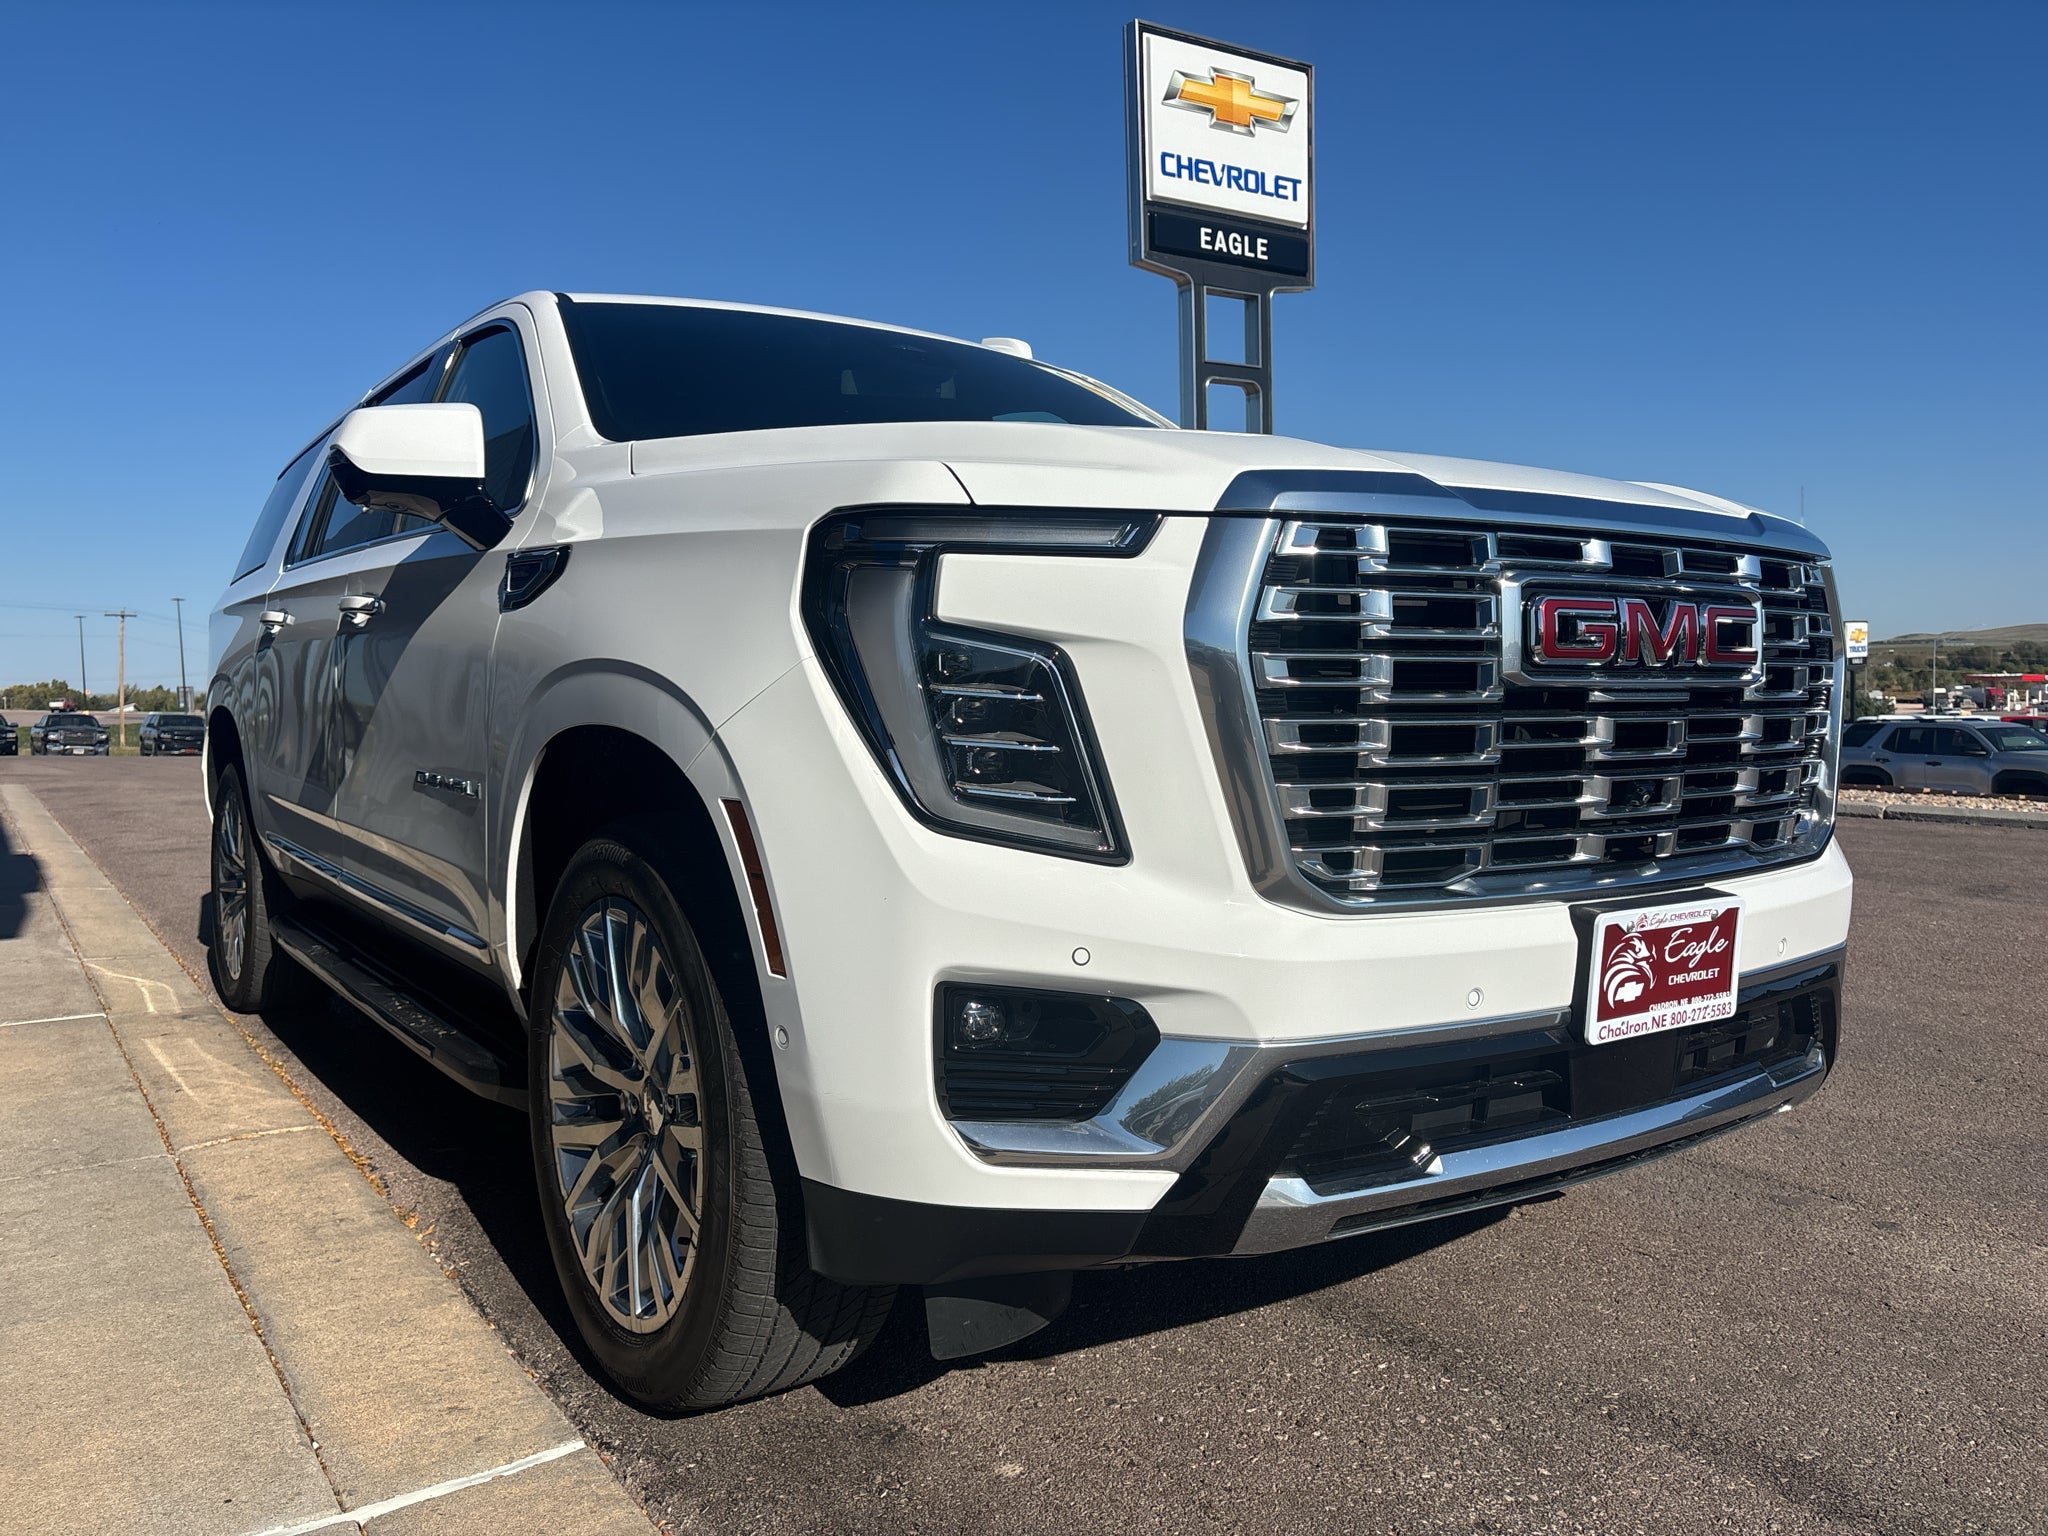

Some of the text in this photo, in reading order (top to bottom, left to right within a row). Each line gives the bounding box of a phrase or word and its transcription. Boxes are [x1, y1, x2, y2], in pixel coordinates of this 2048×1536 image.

[1160, 151, 1302, 202] CHEVROLET
[1199, 227, 1269, 260] EAGLE
[1531, 596, 1757, 667] GMC
[416, 770, 482, 800] DENALI
[1649, 908, 1712, 928] Eagle CHEVROLET
[1664, 925, 1729, 968] Eagle
[1668, 967, 1720, 986] CHEVROLET
[1598, 1001, 1732, 1040] Chadron, NE 800-272-5583
